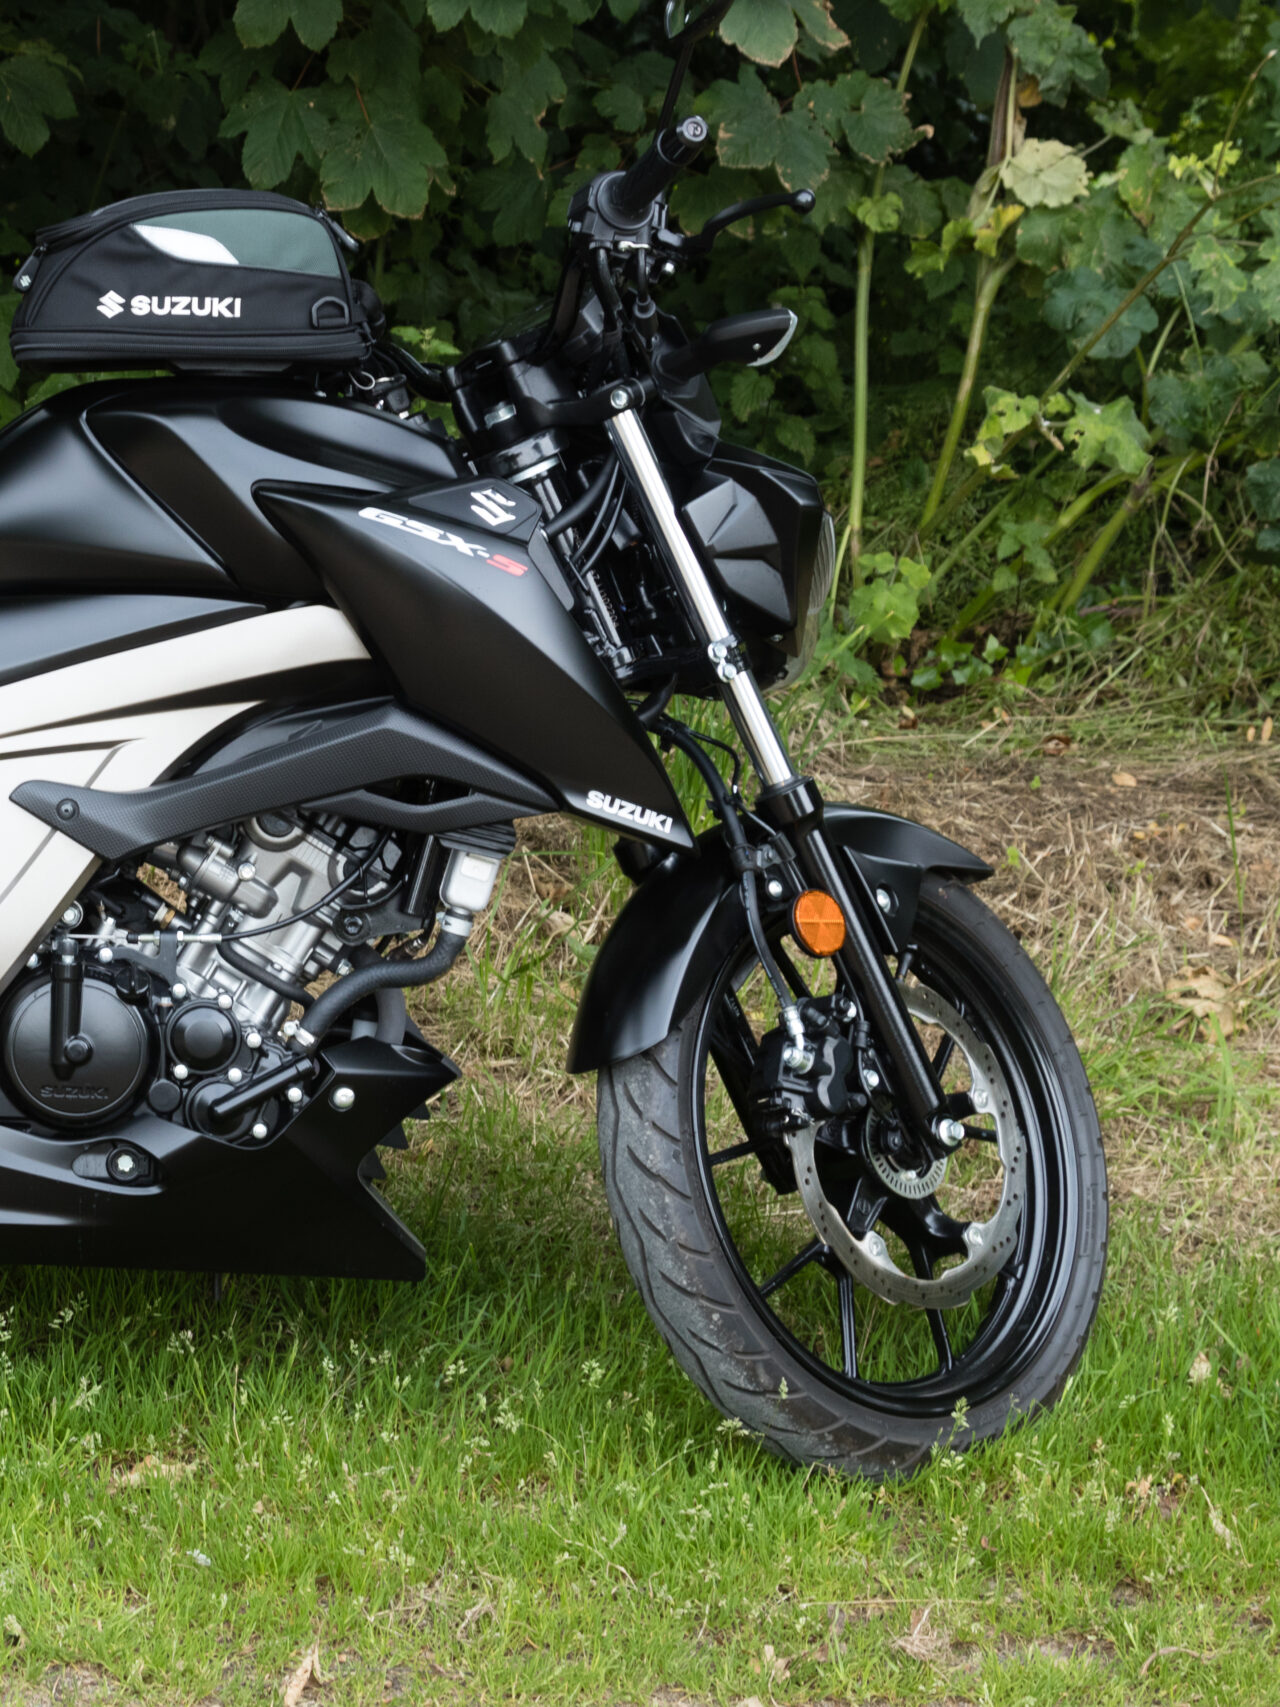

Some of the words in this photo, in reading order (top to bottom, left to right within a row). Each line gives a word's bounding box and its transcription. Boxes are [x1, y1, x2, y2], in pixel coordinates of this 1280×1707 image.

[130, 295, 241, 318] SUZUKI
[586, 790, 673, 834] SUZUKI
[40, 1084, 108, 1099] SUZUKI
